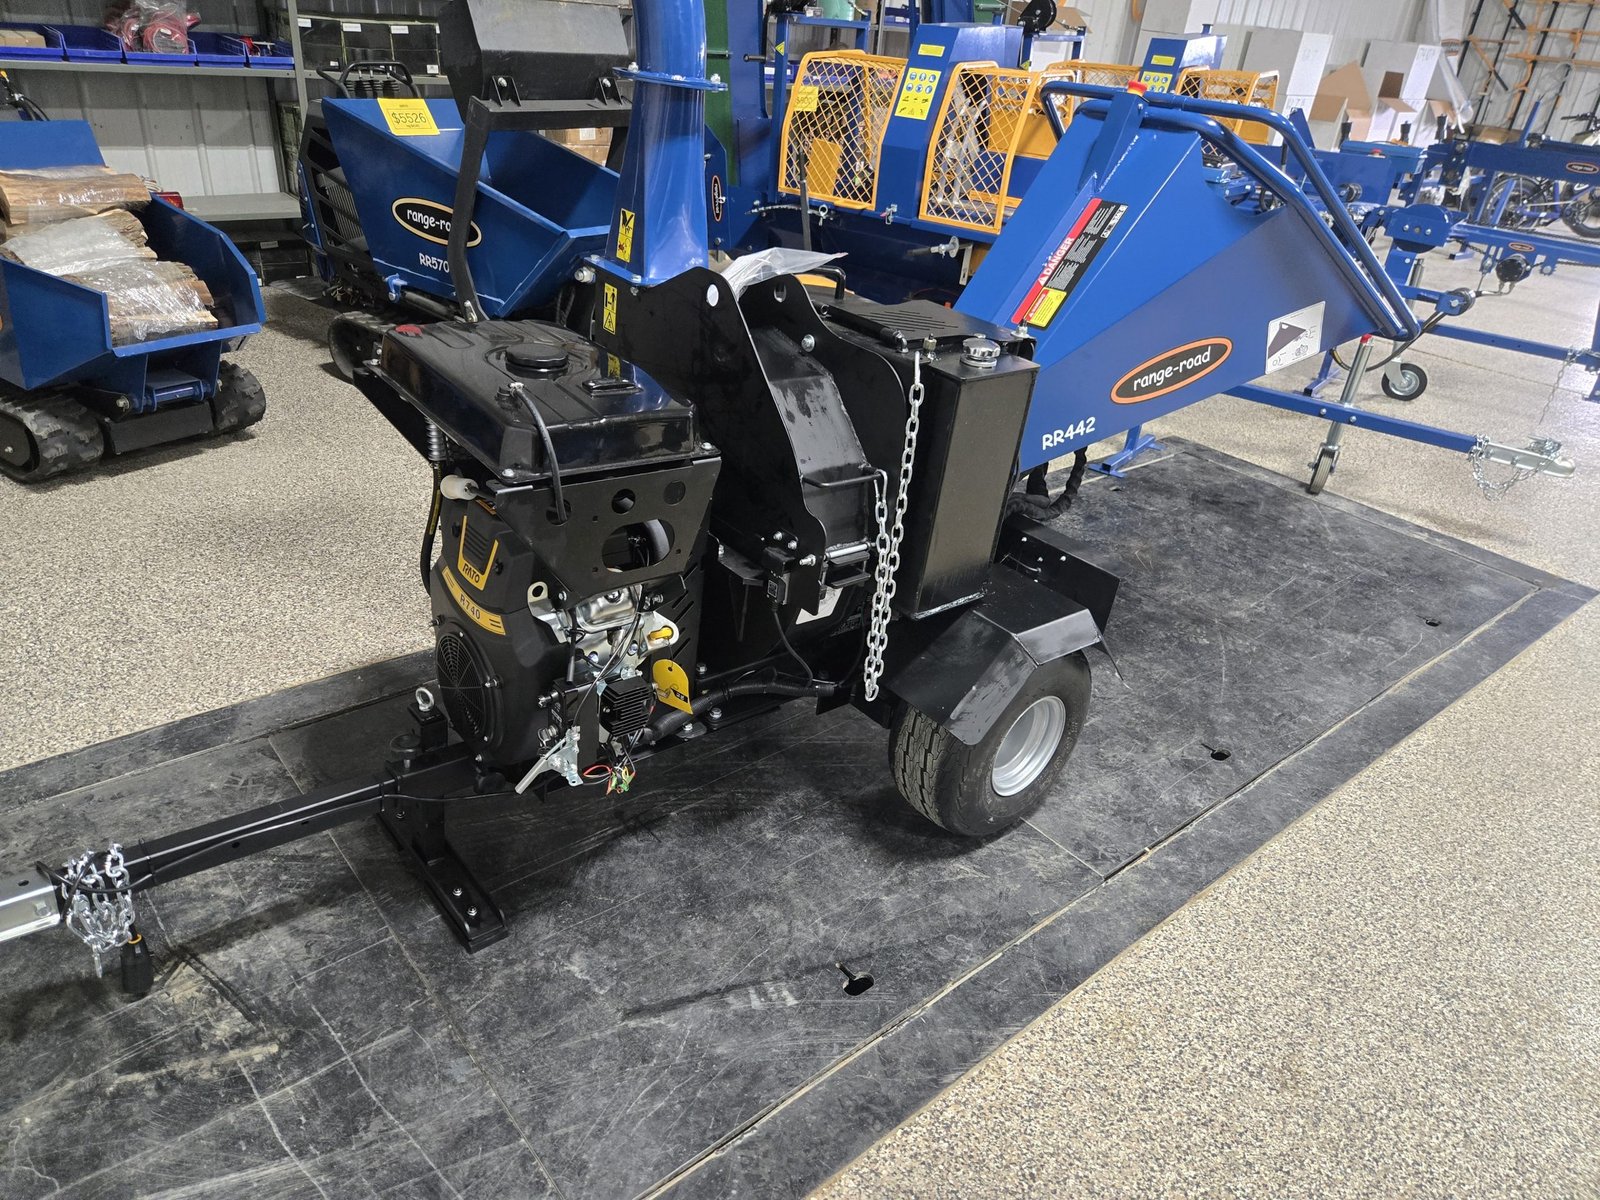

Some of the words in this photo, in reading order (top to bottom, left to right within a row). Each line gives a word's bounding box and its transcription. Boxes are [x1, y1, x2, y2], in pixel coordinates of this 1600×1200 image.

[392, 112, 427, 125] $5526
[407, 209, 452, 232] range-ro
[1042, 237, 1075, 275] DANGER
[1133, 345, 1212, 392] range-road
[1042, 416, 1096, 451] RR442
[462, 563, 481, 584] RATO
[460, 593, 482, 621] R740
